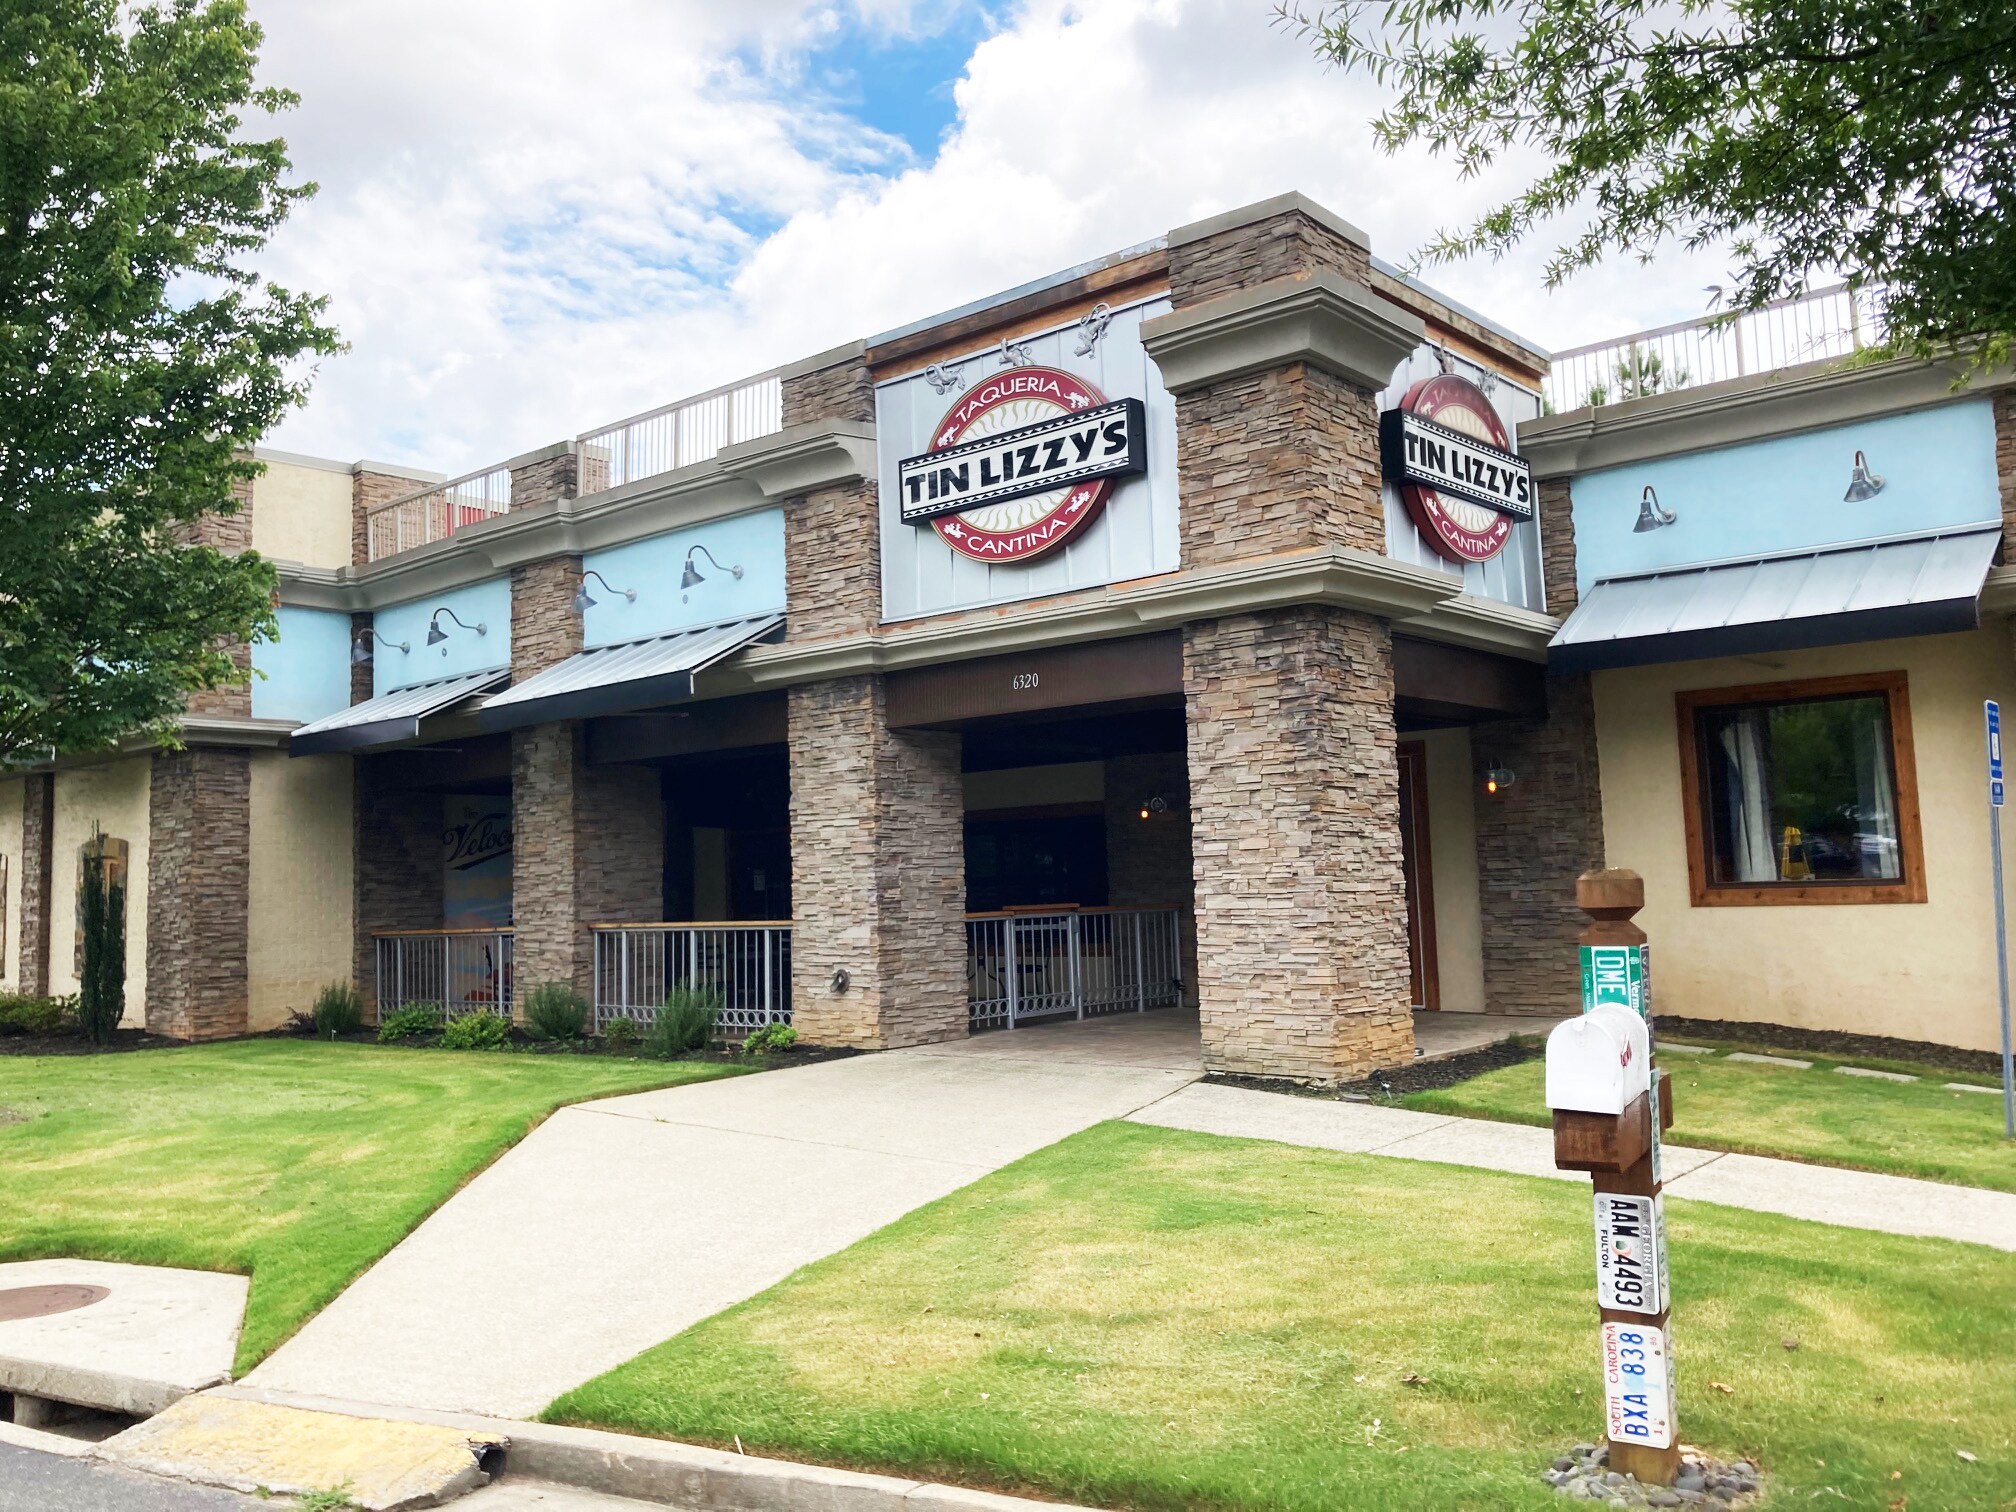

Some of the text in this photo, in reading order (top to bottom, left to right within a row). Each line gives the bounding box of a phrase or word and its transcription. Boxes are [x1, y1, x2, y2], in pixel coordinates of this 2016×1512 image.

[955, 377, 1061, 422] TAQUERIA
[904, 419, 1128, 505] TIN LIZZY'S
[1404, 430, 1530, 503] TIN LIZZY'S
[967, 518, 1067, 554] CANTINA
[1441, 521, 1497, 554] CANTINA
[1013, 672, 1039, 690] 6320
[1595, 956, 1627, 996] DME
[1630, 979, 1642, 1014] Vermo
[1600, 1228, 1610, 1269] FULTON
[1641, 1223, 1653, 1288] GEORGIA
[1613, 1254, 1644, 1308] 4493
[1606, 1325, 1622, 1436] SOUTH CAROLINA
[1619, 1332, 1650, 1438] BXA 838
